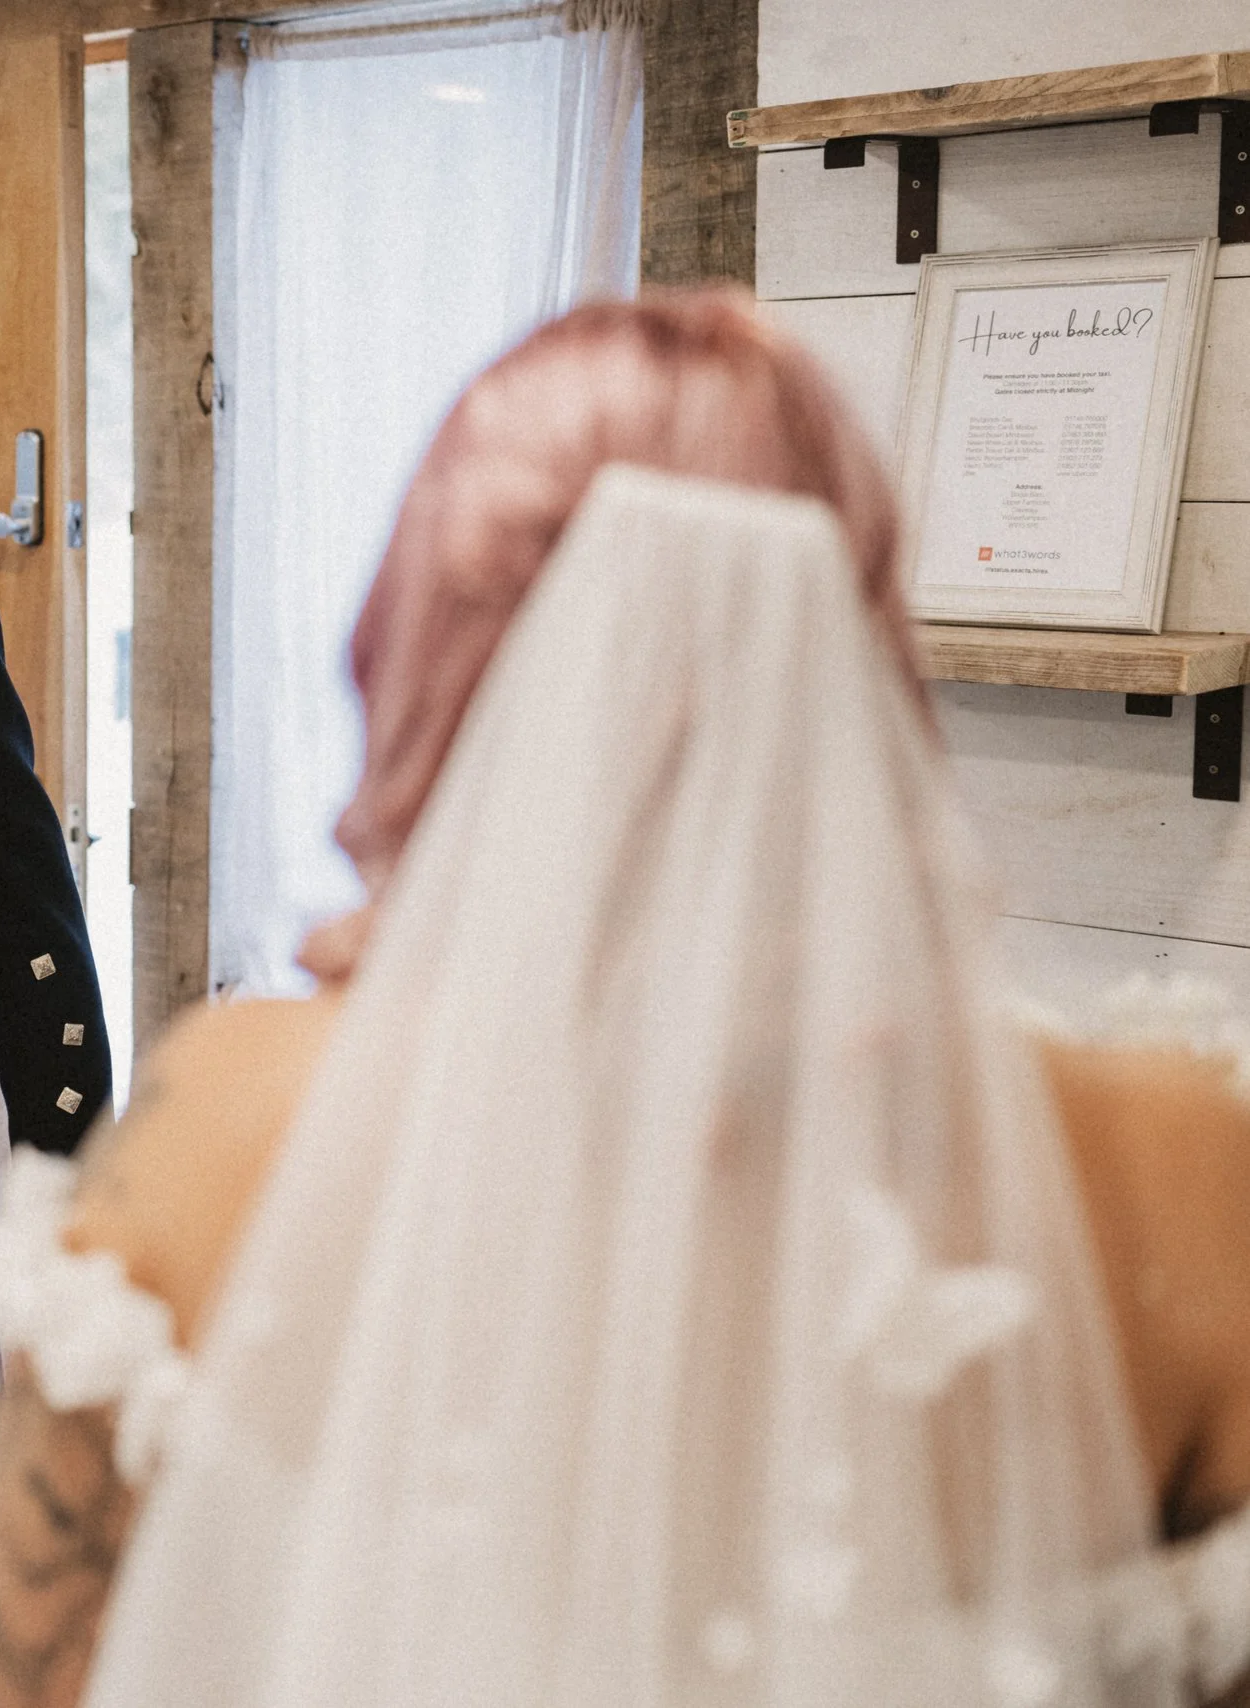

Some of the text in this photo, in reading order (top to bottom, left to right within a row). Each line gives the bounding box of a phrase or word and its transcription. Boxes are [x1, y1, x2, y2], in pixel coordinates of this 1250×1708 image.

[958, 306, 1154, 356] Have you booked?
[994, 548, 1061, 560] what3words
